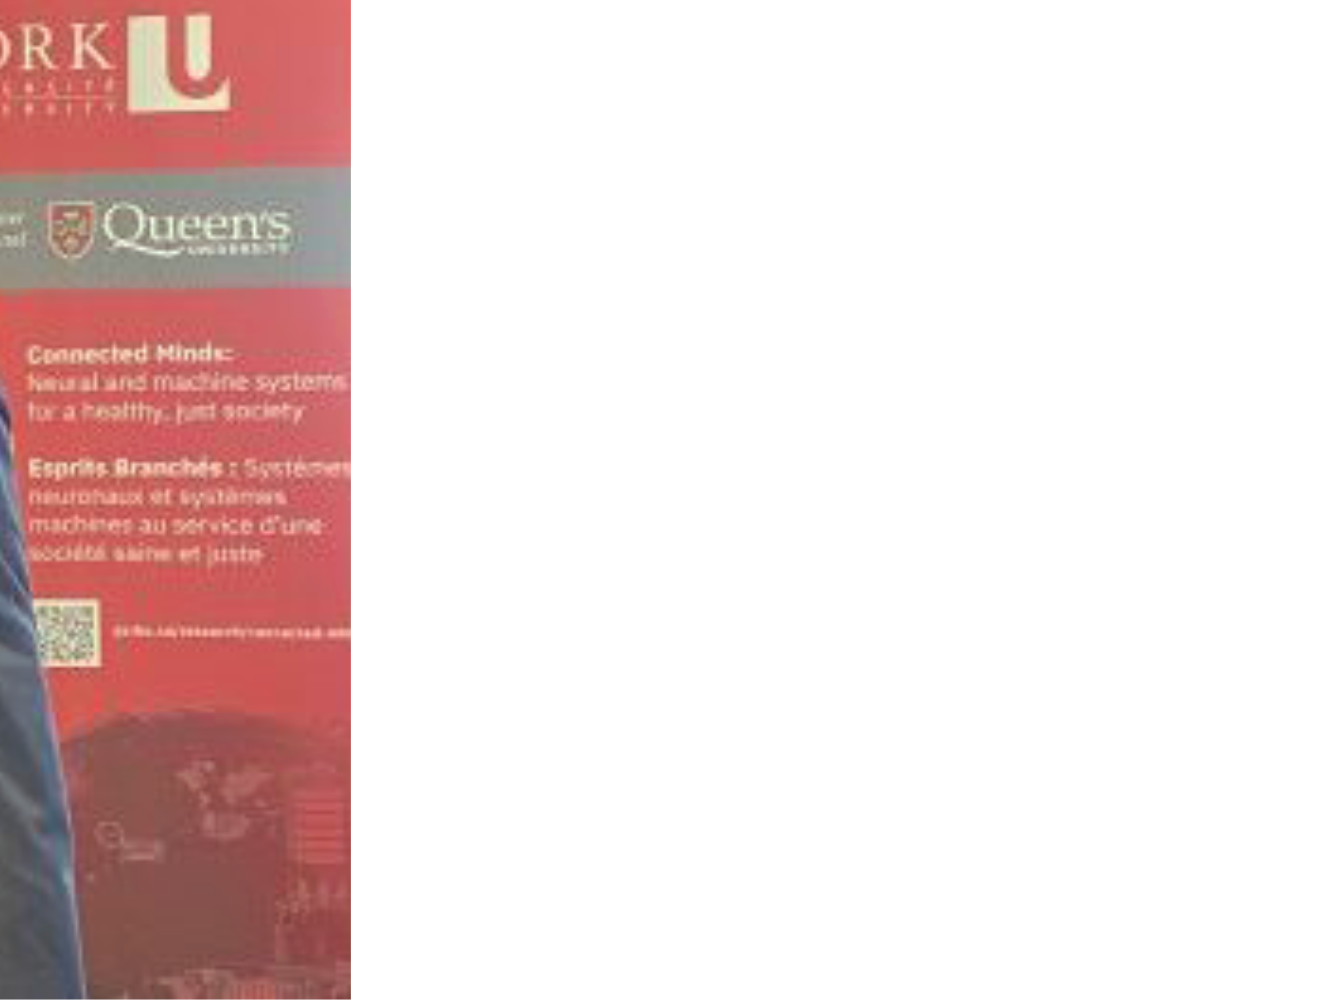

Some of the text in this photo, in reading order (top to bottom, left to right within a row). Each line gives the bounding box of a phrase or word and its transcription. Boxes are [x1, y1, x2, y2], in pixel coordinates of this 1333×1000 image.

[102, 202, 291, 258] Queen's
[27, 341, 233, 365] Connected Minds:
[27, 371, 347, 393] Neural and machine systems
[27, 400, 306, 424] for a healthy, just society
[28, 457, 109, 480] Esprits
[114, 456, 224, 478] Branchés
[29, 486, 287, 508] neuronaux et systèmes
[29, 514, 323, 535] machines au service d'une
[30, 543, 265, 567] société saine et juste
